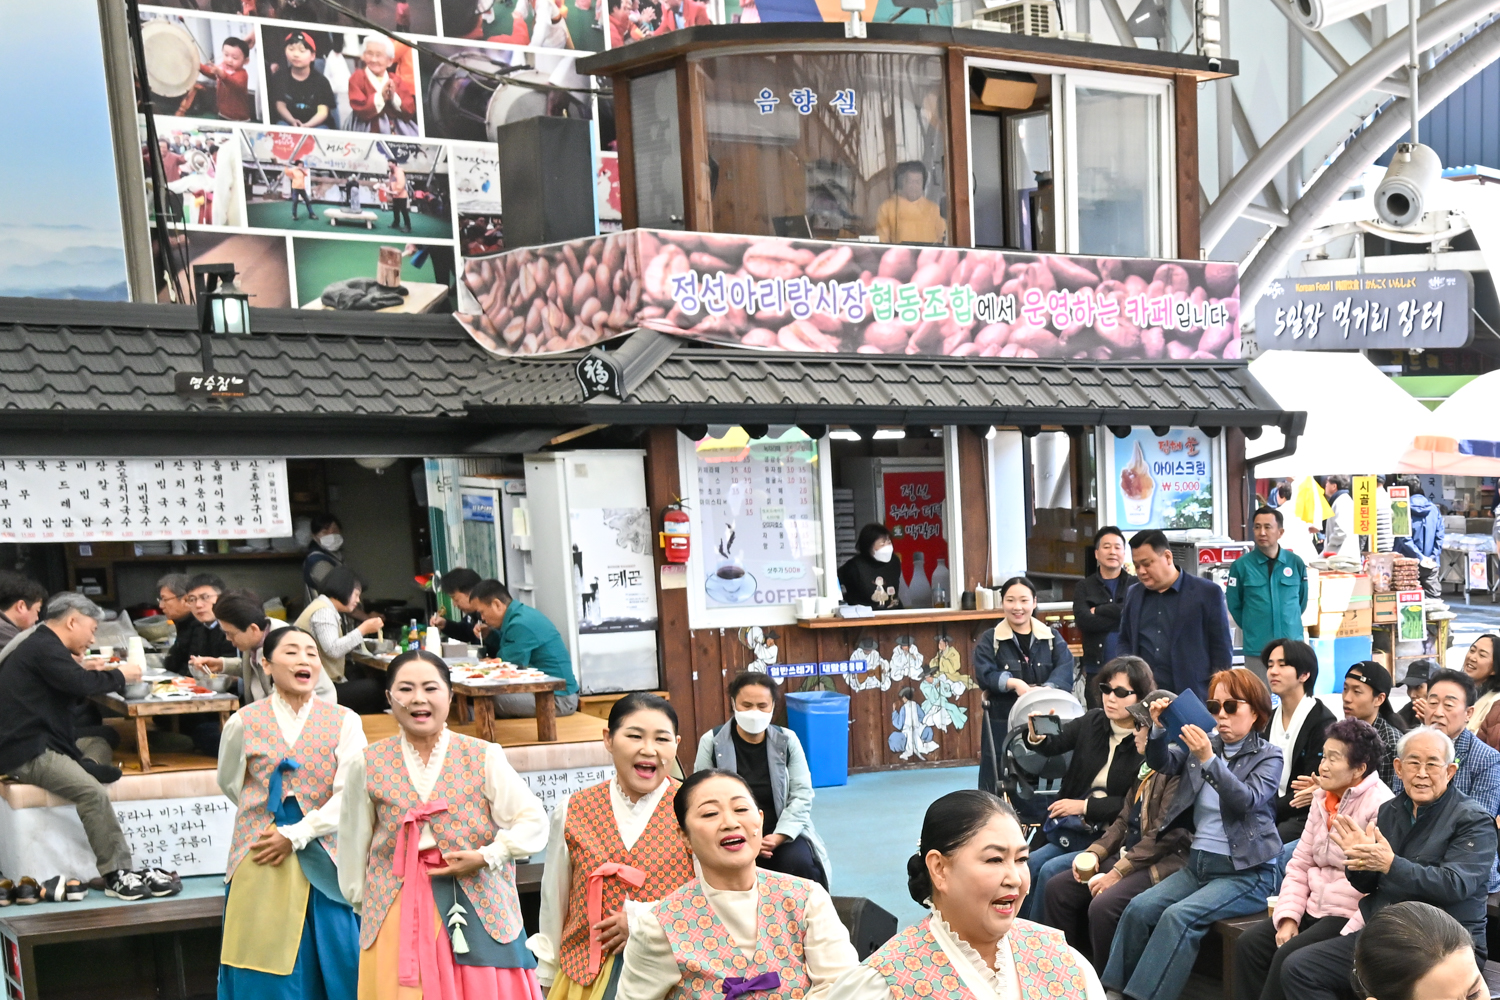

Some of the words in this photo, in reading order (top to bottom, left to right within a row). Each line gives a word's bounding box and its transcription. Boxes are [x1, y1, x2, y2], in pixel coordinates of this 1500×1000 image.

[1295, 282, 1315, 292] Korean
[1316, 281, 1330, 291] Food
[671, 270, 1016, 323] 정선아리랑시장협동조합에서
[1021, 290, 1120, 327] 운영하는
[1125, 297, 1228, 328] 카페입니다
[1273, 299, 1326, 340] 5일장
[1331, 296, 1390, 340] 먹거리
[1397, 298, 1445, 338] 장터
[900, 483, 931, 501] 정선
[1174, 481, 1200, 492] 5,000
[905, 521, 940, 540] 막걸리
[160, 805, 185, 818] 비가
[191, 801, 229, 815] 올라나
[168, 819, 206, 835] 질라나
[143, 839, 168, 854] 검은
[175, 835, 212, 849] 구름이
